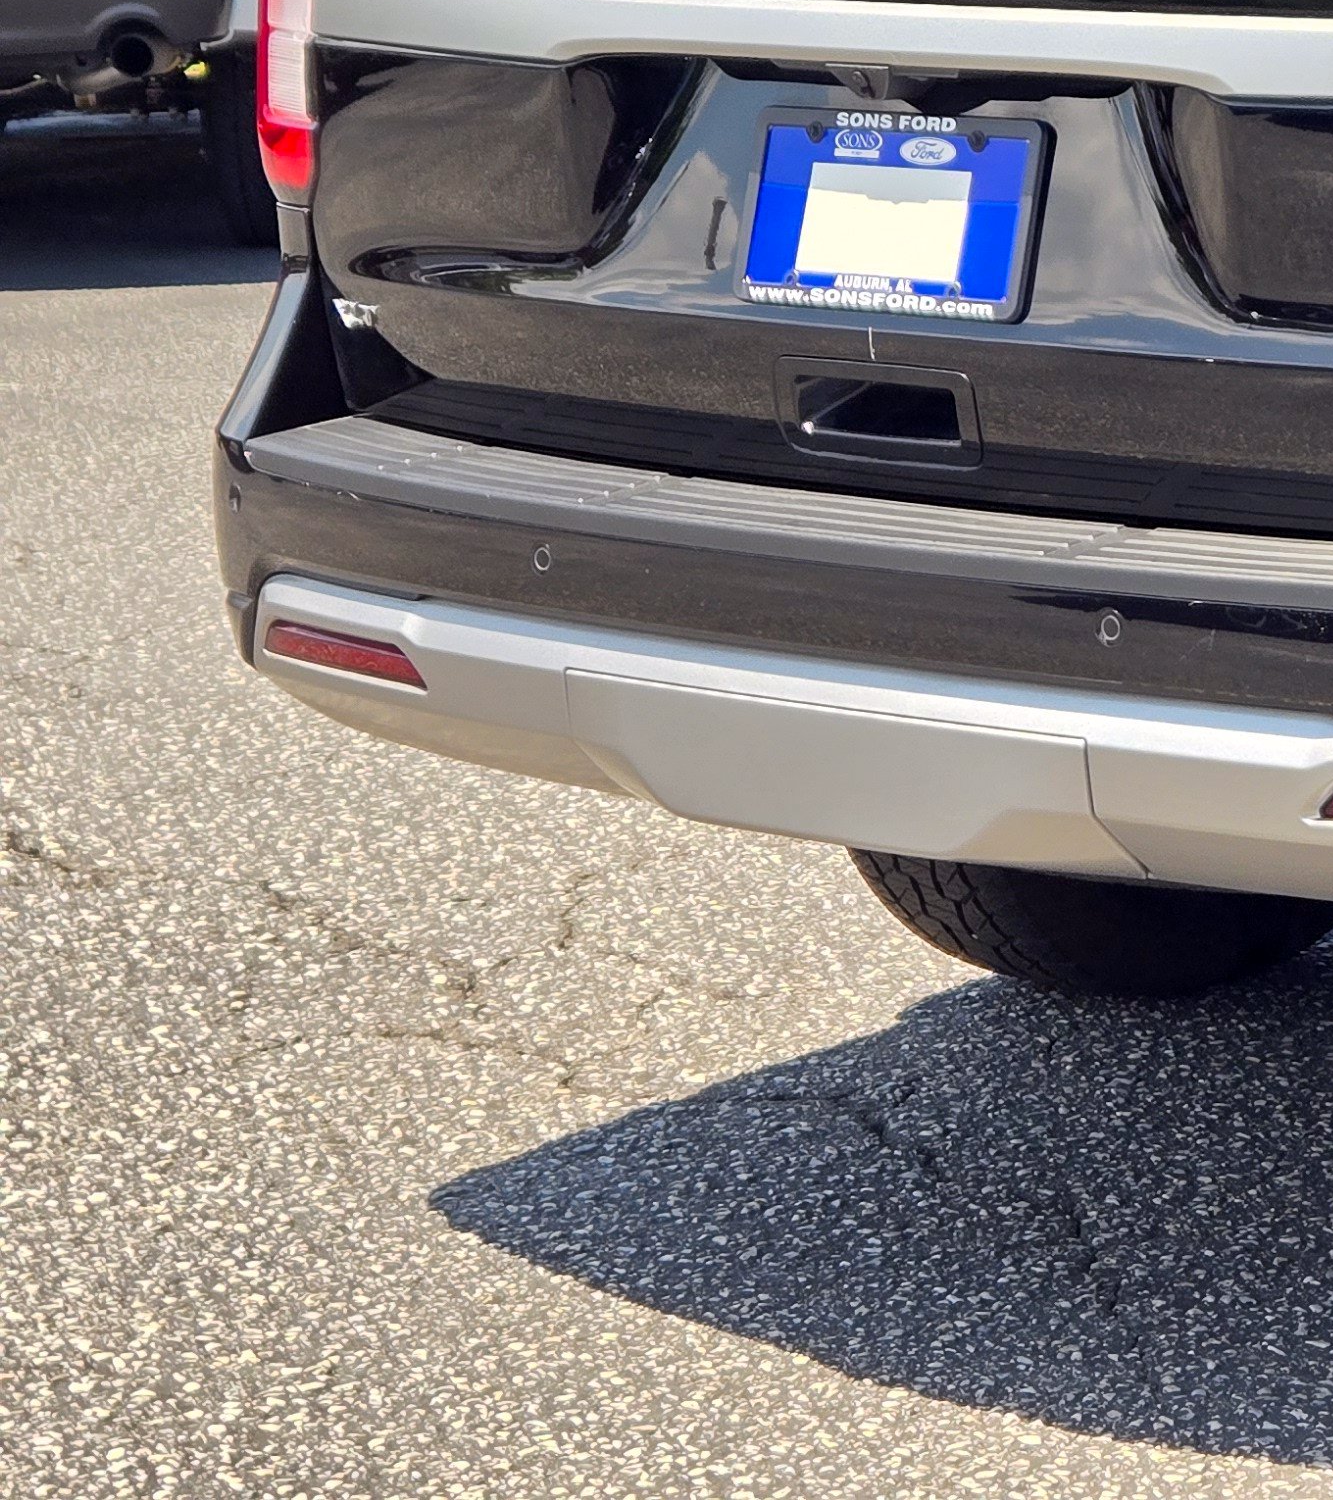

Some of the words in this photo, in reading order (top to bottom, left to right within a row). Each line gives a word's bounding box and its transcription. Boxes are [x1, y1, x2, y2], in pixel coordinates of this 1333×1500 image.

[836, 111, 893, 130] SONS
[898, 115, 957, 132] FORD
[840, 132, 877, 150] SONS
[910, 141, 946, 160] Ford
[749, 285, 993, 316] www.SONSFORD.com
